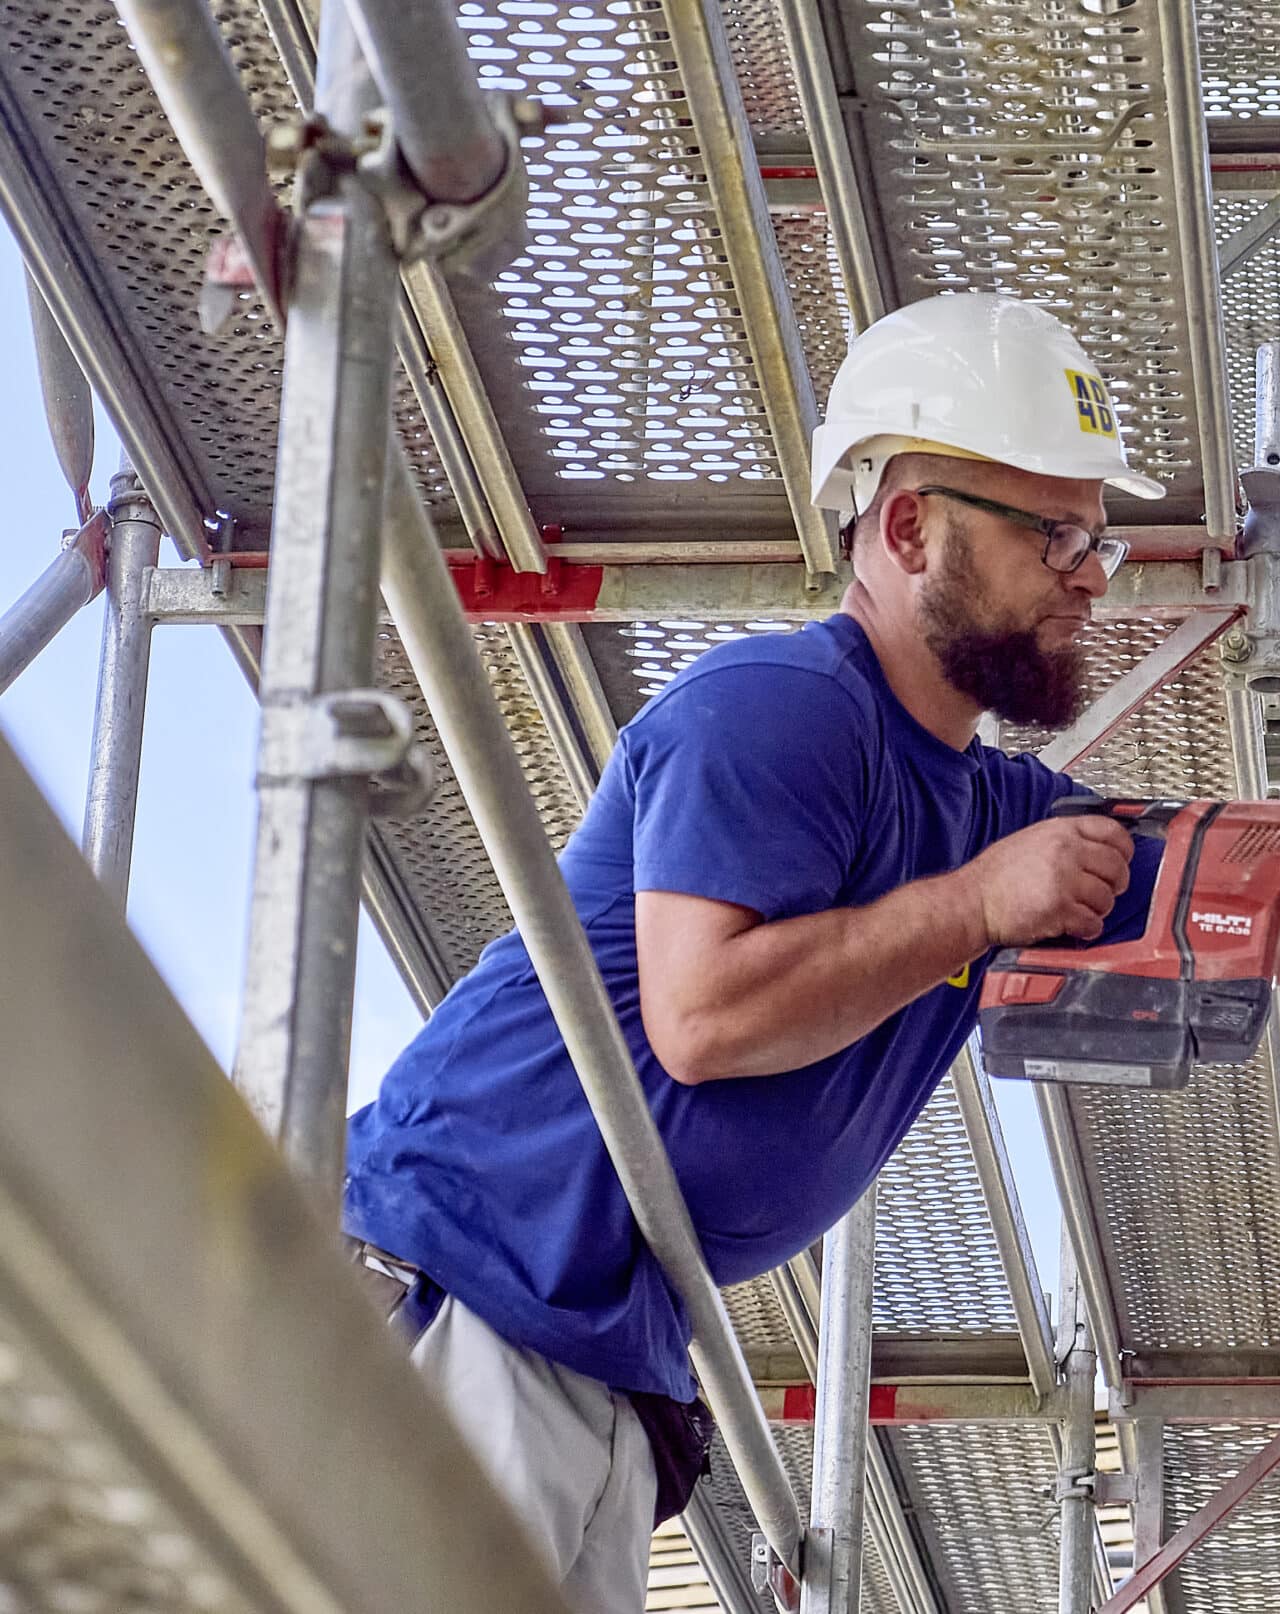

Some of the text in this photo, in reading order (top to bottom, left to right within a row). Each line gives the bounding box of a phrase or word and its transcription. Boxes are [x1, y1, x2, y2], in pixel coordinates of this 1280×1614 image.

[1075, 375, 1113, 432] 4B
[1191, 911, 1252, 928] HILTI
[1199, 922, 1213, 932] TE
